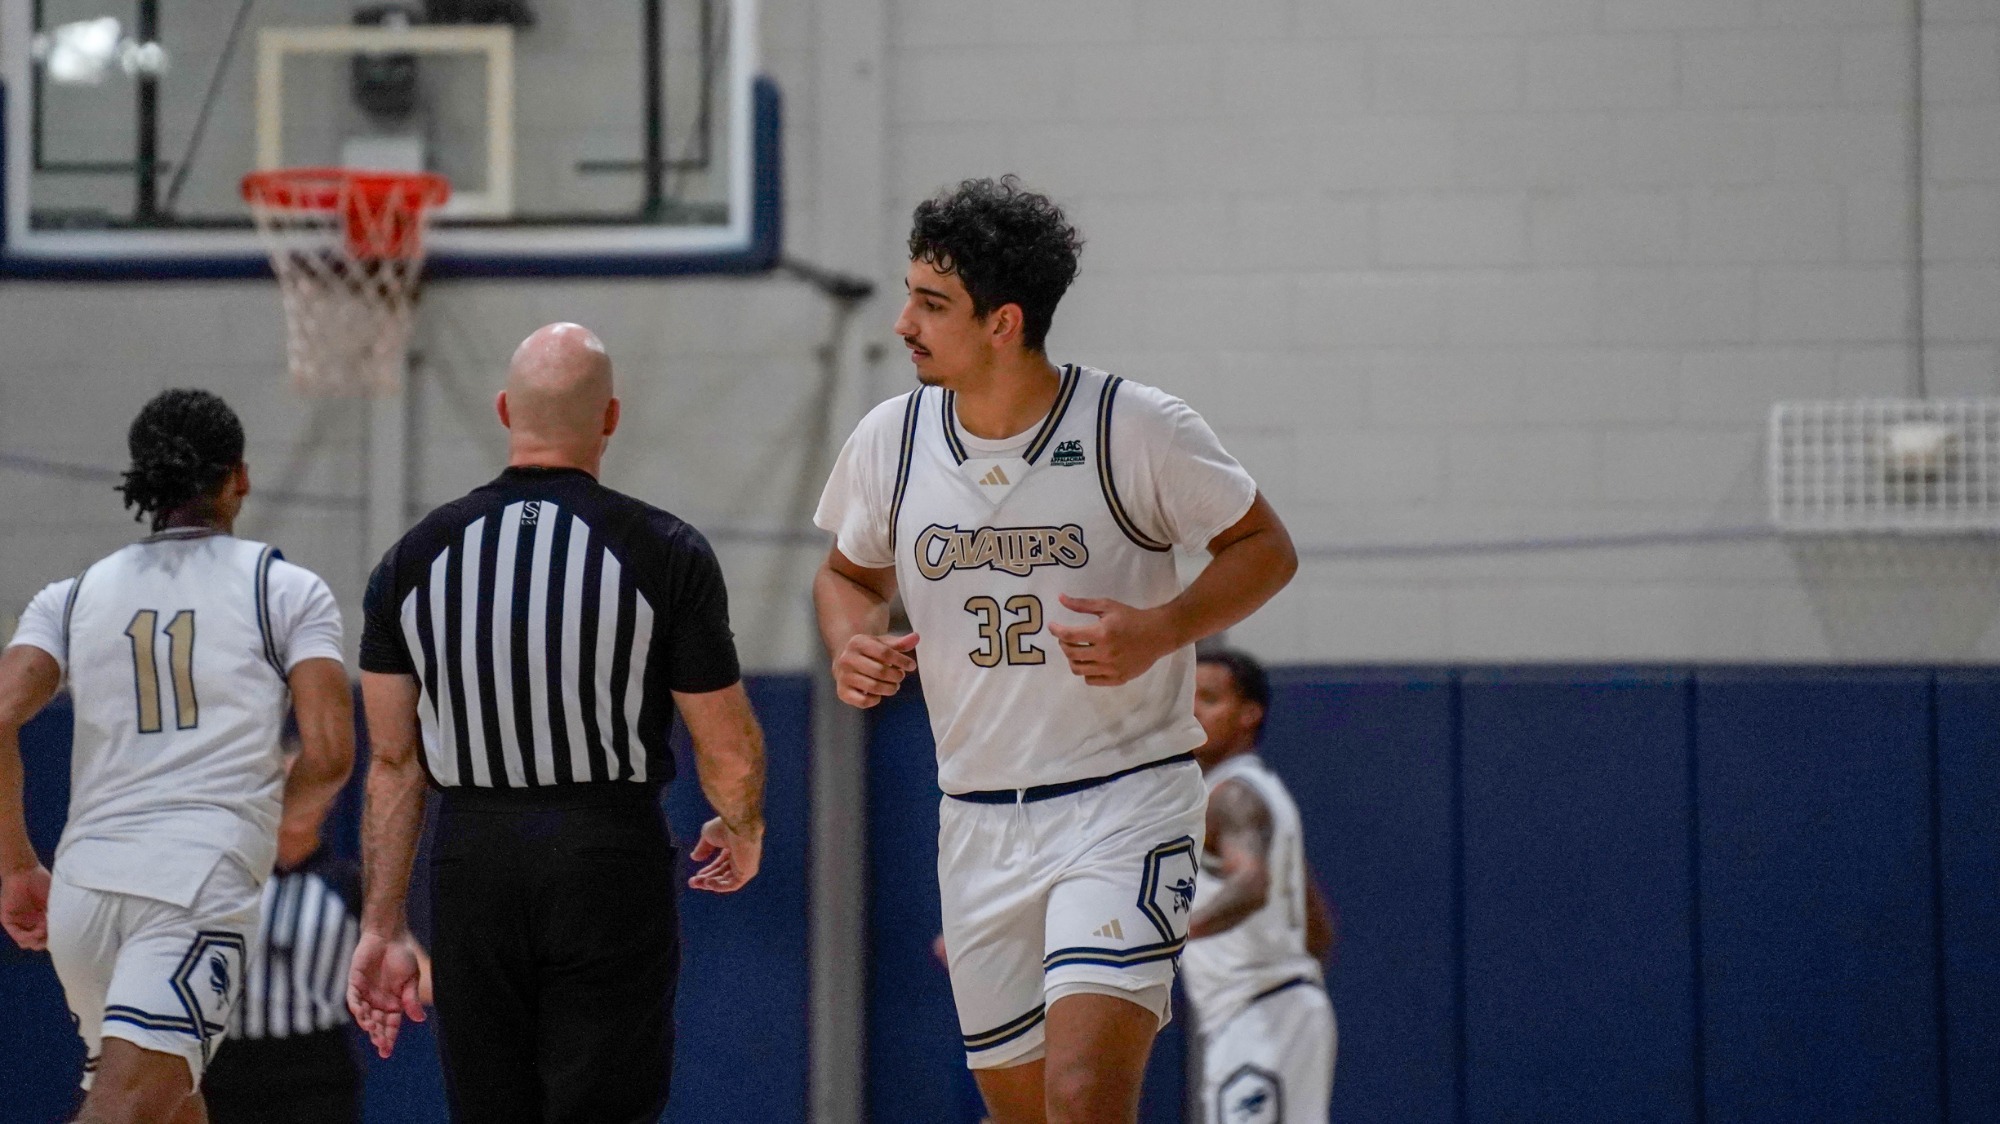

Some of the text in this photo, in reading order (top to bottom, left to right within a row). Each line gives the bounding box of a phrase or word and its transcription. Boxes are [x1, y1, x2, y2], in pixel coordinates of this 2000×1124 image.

[1057, 440, 1081, 451] AAC
[915, 523, 1089, 581] CAVALIERS
[964, 594, 1046, 668] 32
[124, 609, 199, 734] 11
